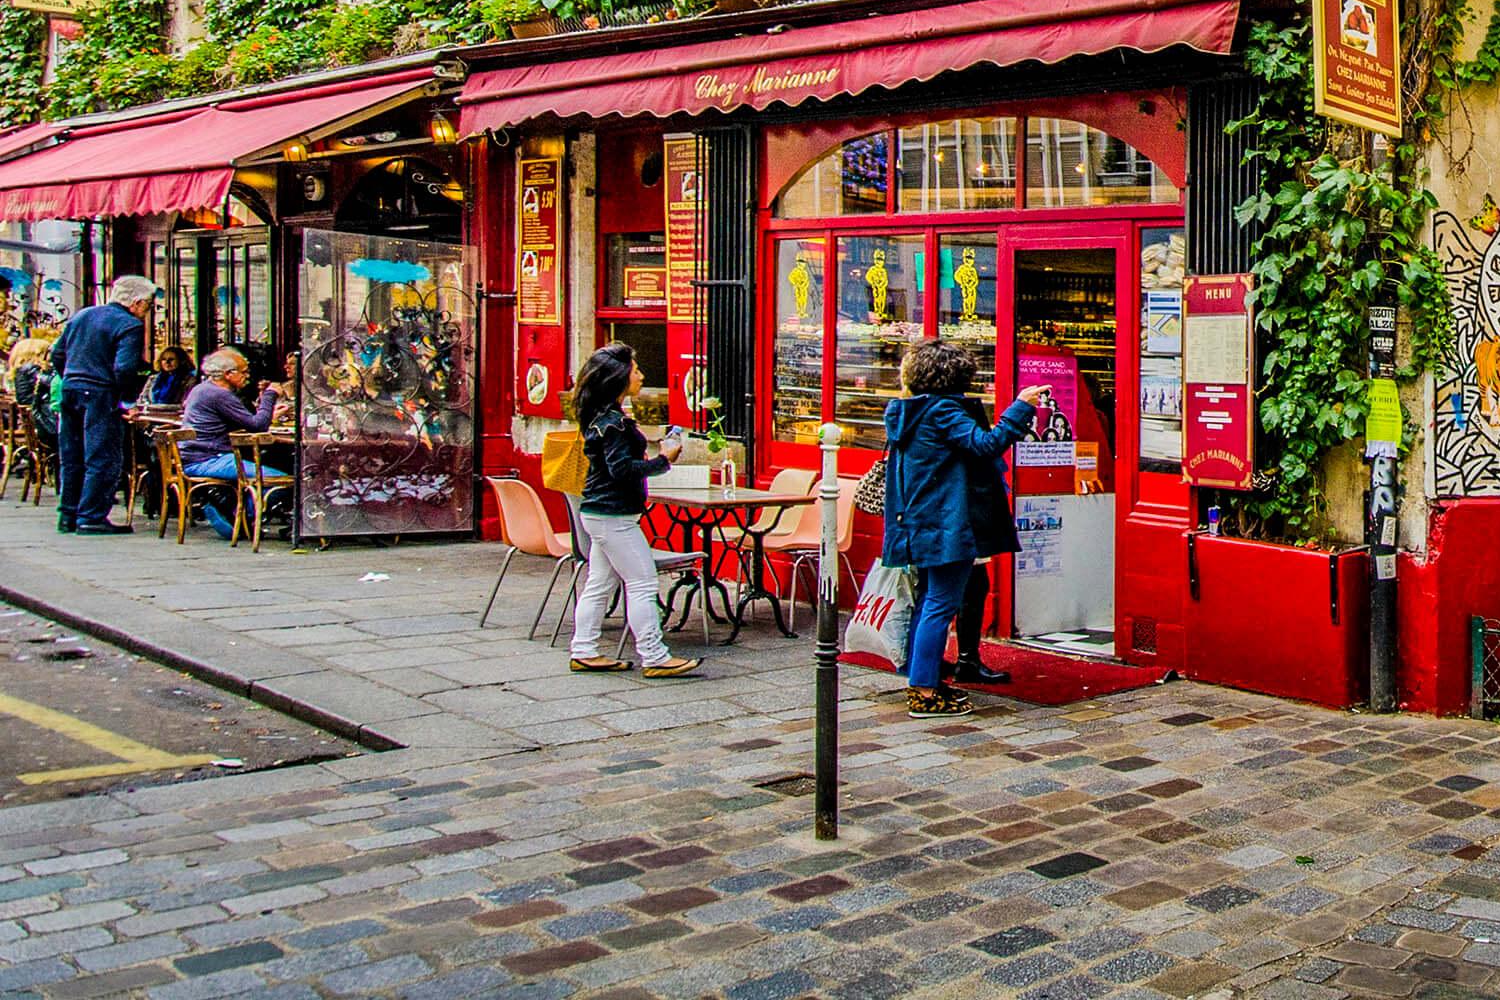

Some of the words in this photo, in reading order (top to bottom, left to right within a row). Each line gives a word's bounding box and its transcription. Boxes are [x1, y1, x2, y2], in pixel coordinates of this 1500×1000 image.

[694, 74, 739, 106] Chez
[743, 66, 840, 94] Marianne
[1205, 288, 1232, 300] MENU
[1019, 360, 1046, 368] GEORGE
[1189, 452, 1205, 469] CHEZ
[1207, 449, 1245, 472] MARIANNE
